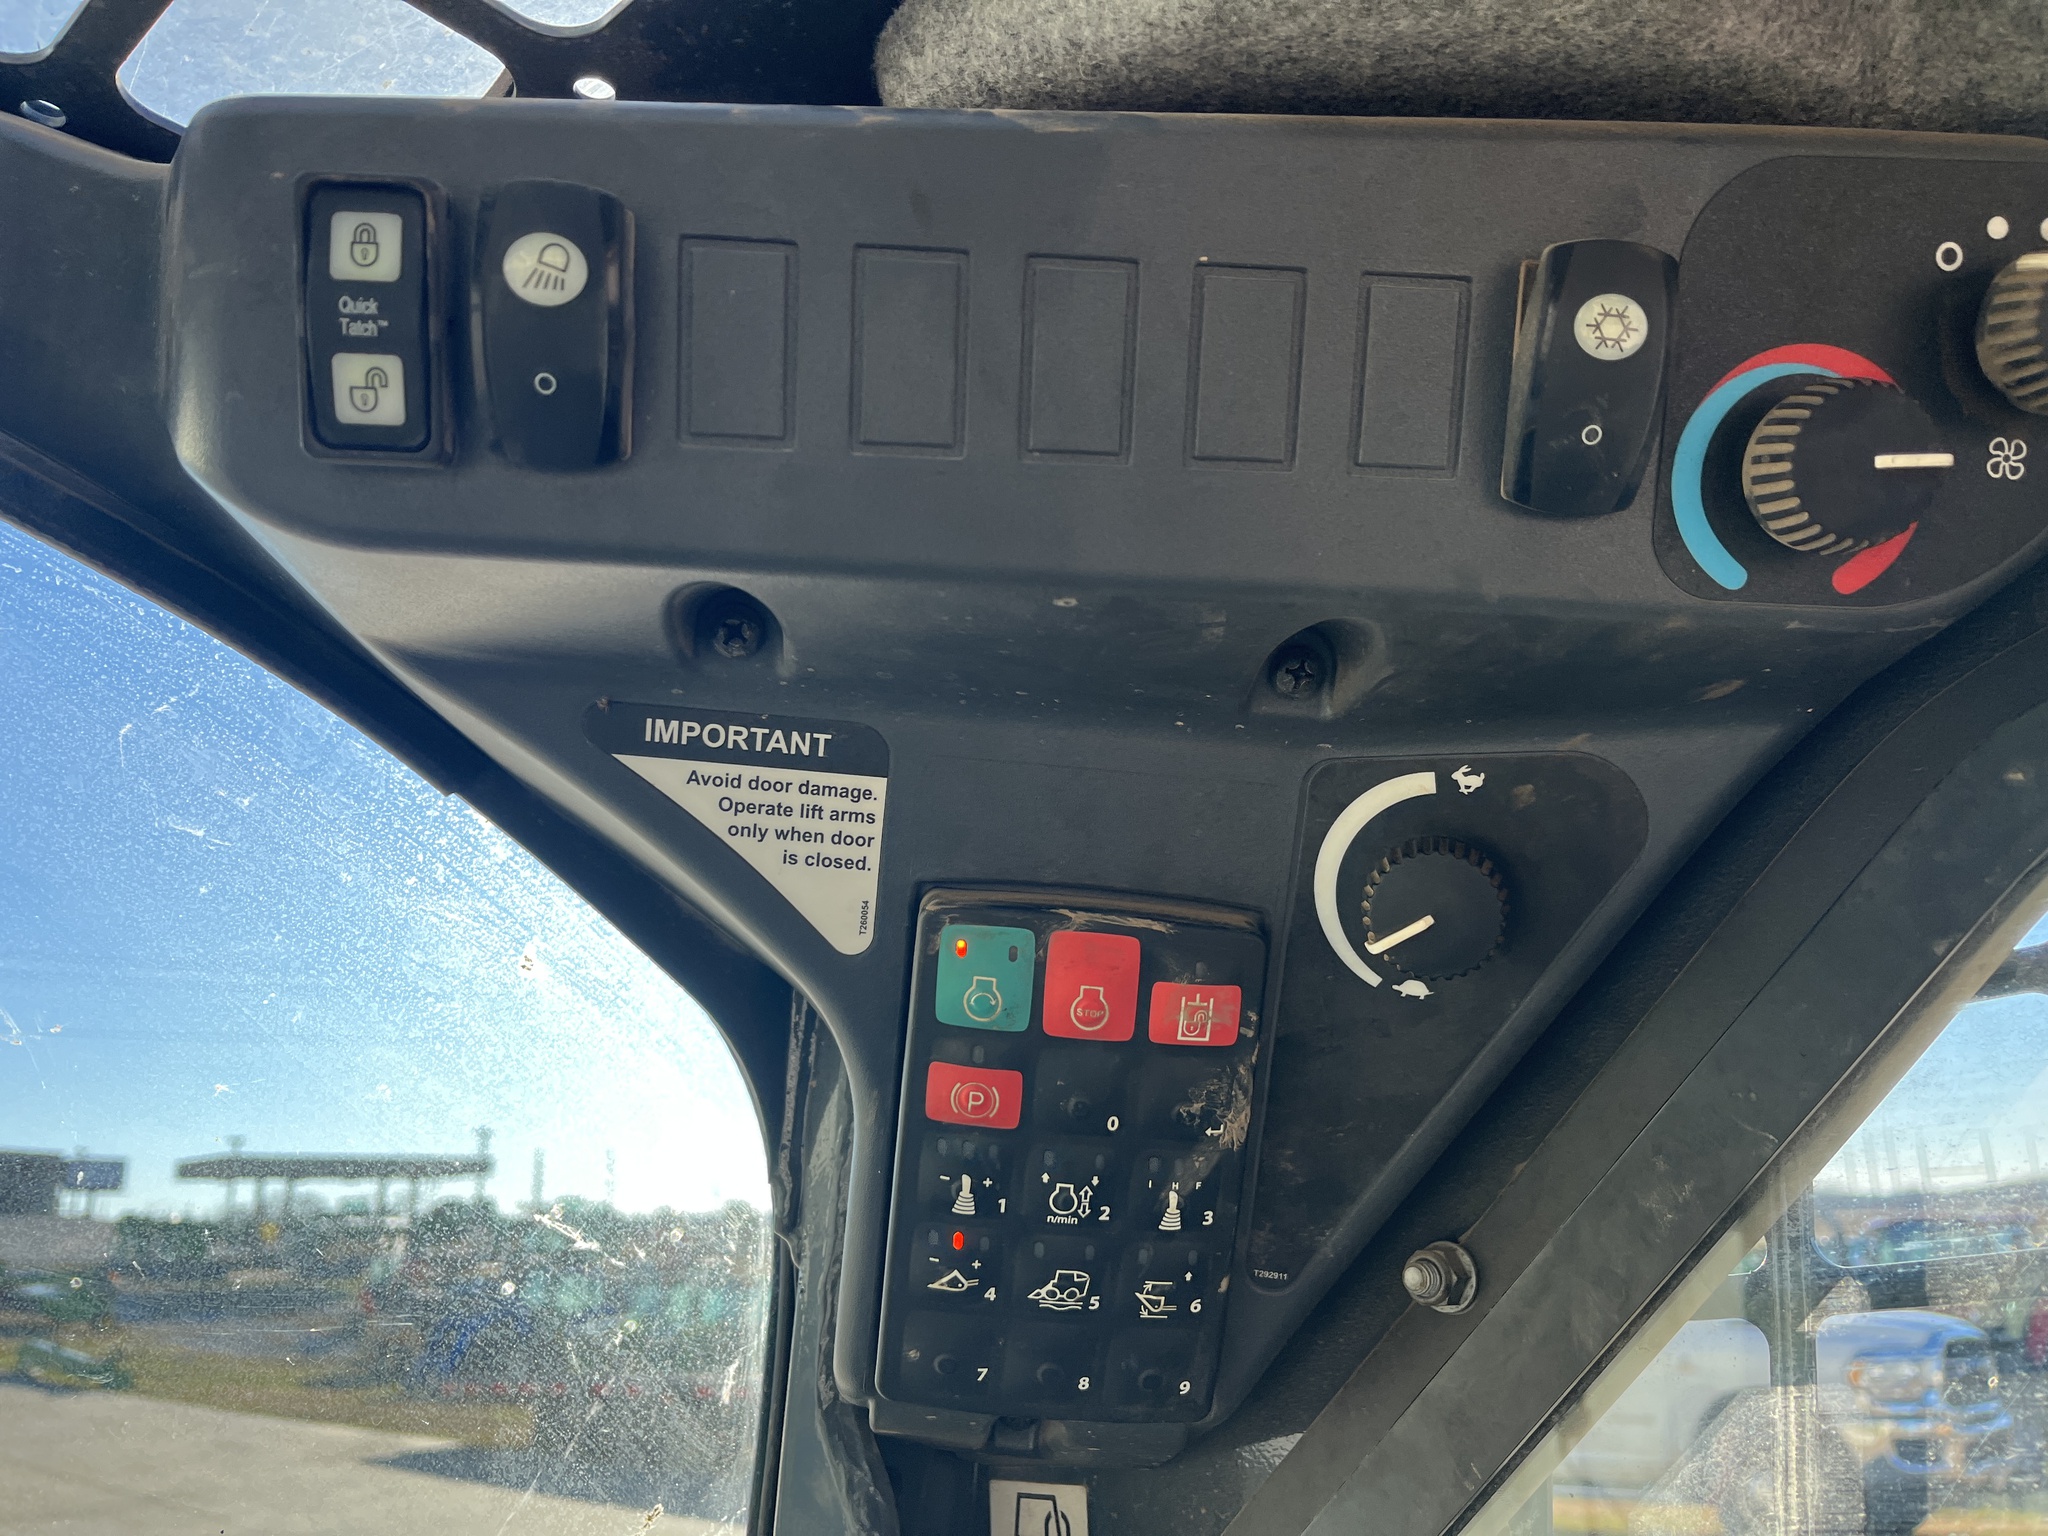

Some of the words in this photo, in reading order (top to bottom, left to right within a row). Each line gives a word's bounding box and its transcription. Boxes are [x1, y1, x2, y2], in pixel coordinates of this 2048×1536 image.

[644, 717, 832, 758] IMPORTANT
[686, 769, 742, 789] Avoid
[748, 774, 793, 794] door
[798, 779, 878, 803] damage.
[718, 796, 794, 817] Operate
[800, 803, 824, 821] lift
[829, 809, 876, 825] arms
[727, 823, 769, 843] only
[775, 827, 825, 844] when
[830, 831, 875, 848] door
[782, 849, 798, 865] is
[804, 851, 872, 872] closed.
[858, 900, 869, 936] T260054
[1076, 1007, 1104, 1018] STOP
[967, 1090, 985, 1113] P
[1107, 1115, 1119, 1132] 0
[998, 1198, 1007, 1214] 1
[1098, 1206, 1111, 1222] 2
[1046, 1213, 1078, 1225] n/min
[1202, 1210, 1214, 1226] 3
[1253, 1269, 1288, 1280] T292911
[983, 1286, 997, 1302] 4
[1088, 1296, 1100, 1311] 5
[1189, 1298, 1202, 1313] 6
[976, 1367, 988, 1382] 7
[1077, 1376, 1090, 1391] 8
[1178, 1380, 1191, 1396] 9
